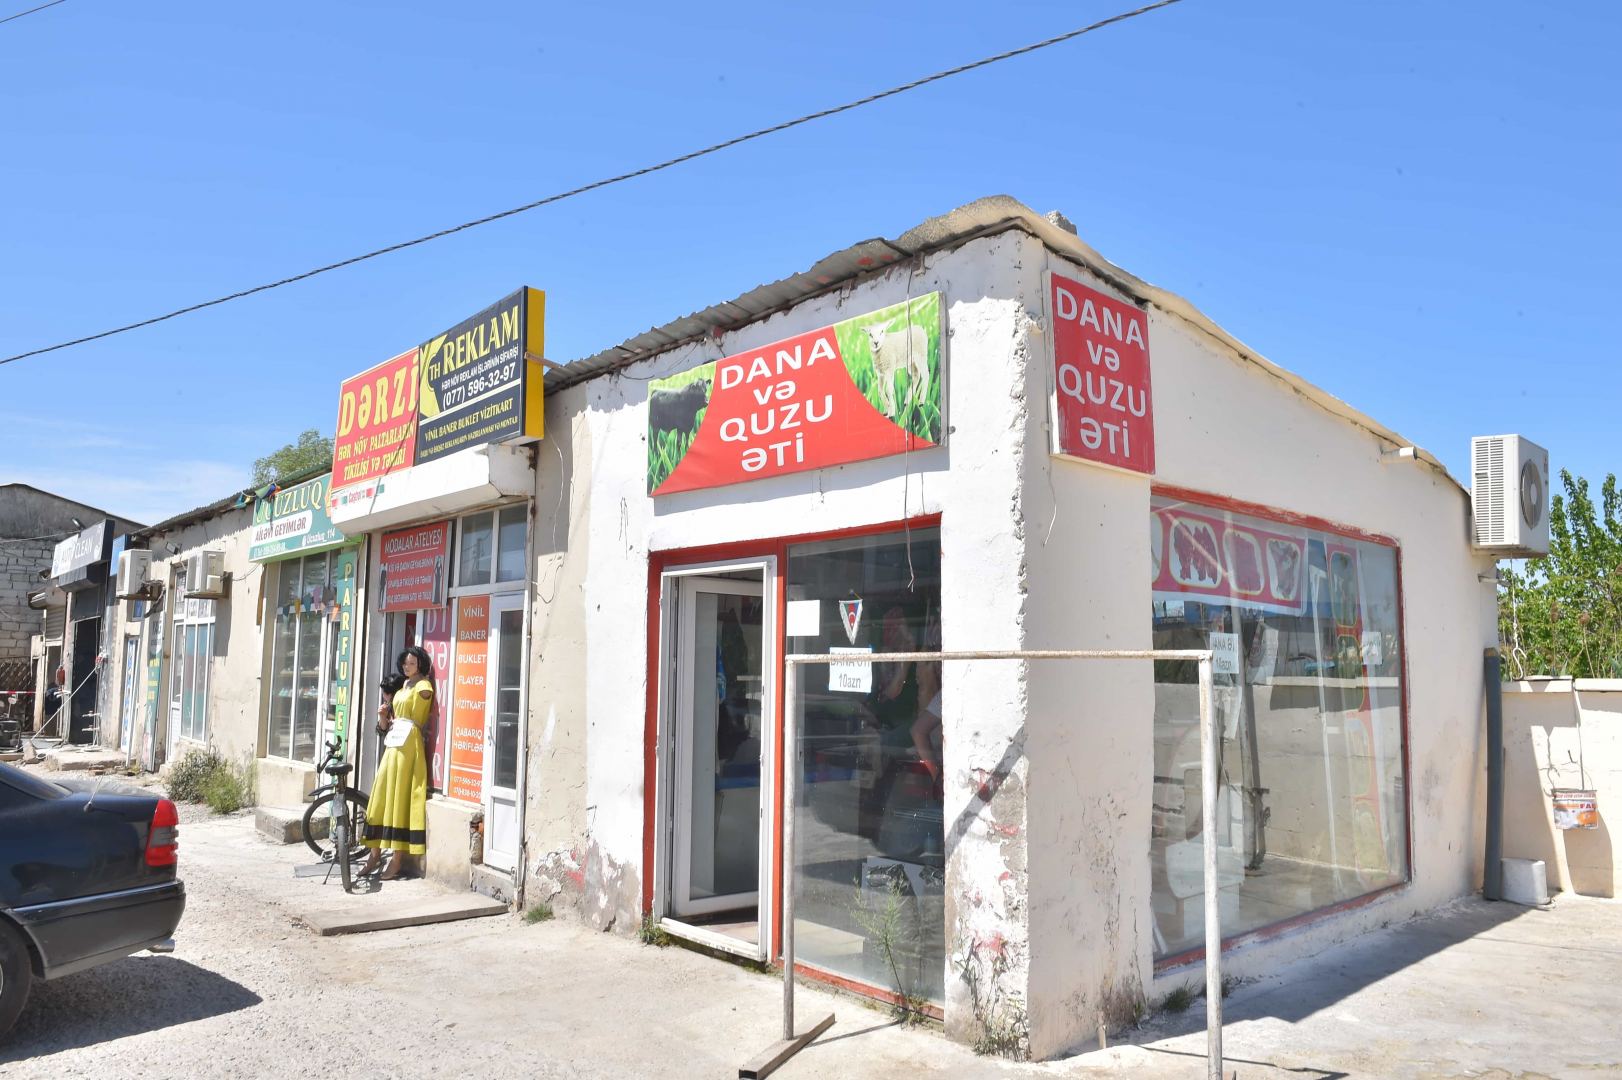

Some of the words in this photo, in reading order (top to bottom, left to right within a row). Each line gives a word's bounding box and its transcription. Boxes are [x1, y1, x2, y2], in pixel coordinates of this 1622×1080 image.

[1056, 286, 1145, 350] DANA
[429, 361, 441, 380] TH
[443, 305, 519, 375] REKLAM
[459, 365, 477, 382] REKLAM
[720, 337, 836, 390] DANA
[339, 354, 418, 437] DƏRZİ
[443, 385, 466, 411] (077)
[467, 362, 516, 397] 596-32-97
[1058, 363, 1146, 418] QUZU
[439, 420, 458, 437] BANER
[458, 412, 480, 429] BUKLET
[719, 394, 833, 442] QUZU
[338, 444, 352, 461] HƏR
[353, 436, 368, 456] NÖV
[1080, 416, 1130, 458] ƏTİ
[371, 456, 380, 472] VƏ
[741, 432, 804, 472] ƏTİ
[274, 517, 307, 536] GEYİMLƏR
[463, 605, 485, 617] VİNİL
[336, 563, 352, 731] PARFUME
[460, 630, 486, 640] BANER
[458, 654, 487, 664] BUKLET
[458, 675, 484, 686] FLAYER
[838, 673, 861, 689] 10azn
[455, 727, 483, 740] QABARIQ
